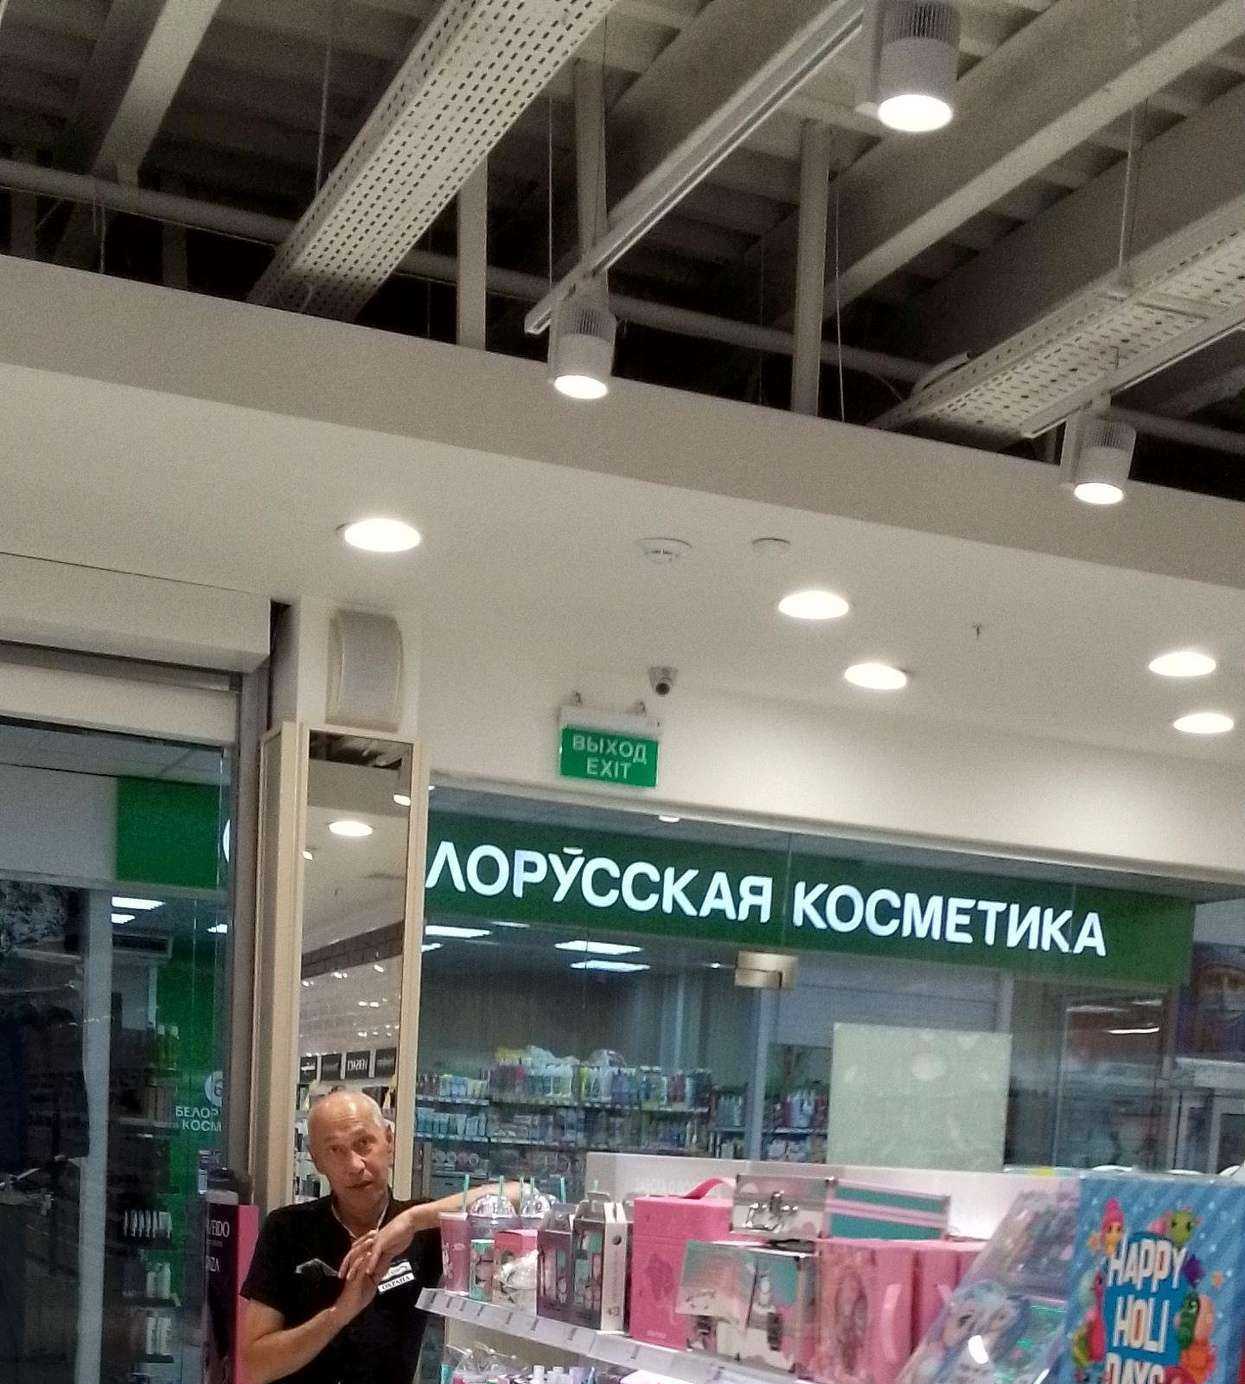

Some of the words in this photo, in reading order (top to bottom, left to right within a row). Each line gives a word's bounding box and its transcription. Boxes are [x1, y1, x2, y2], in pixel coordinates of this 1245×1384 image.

[572, 735, 647, 765] ВЫХОД
[587, 757, 632, 779] EXIT
[792, 881, 1107, 957] КОСМЕТИКА
[1107, 1233, 1186, 1292] HAPPY
[1112, 1295, 1170, 1353] HOLI
